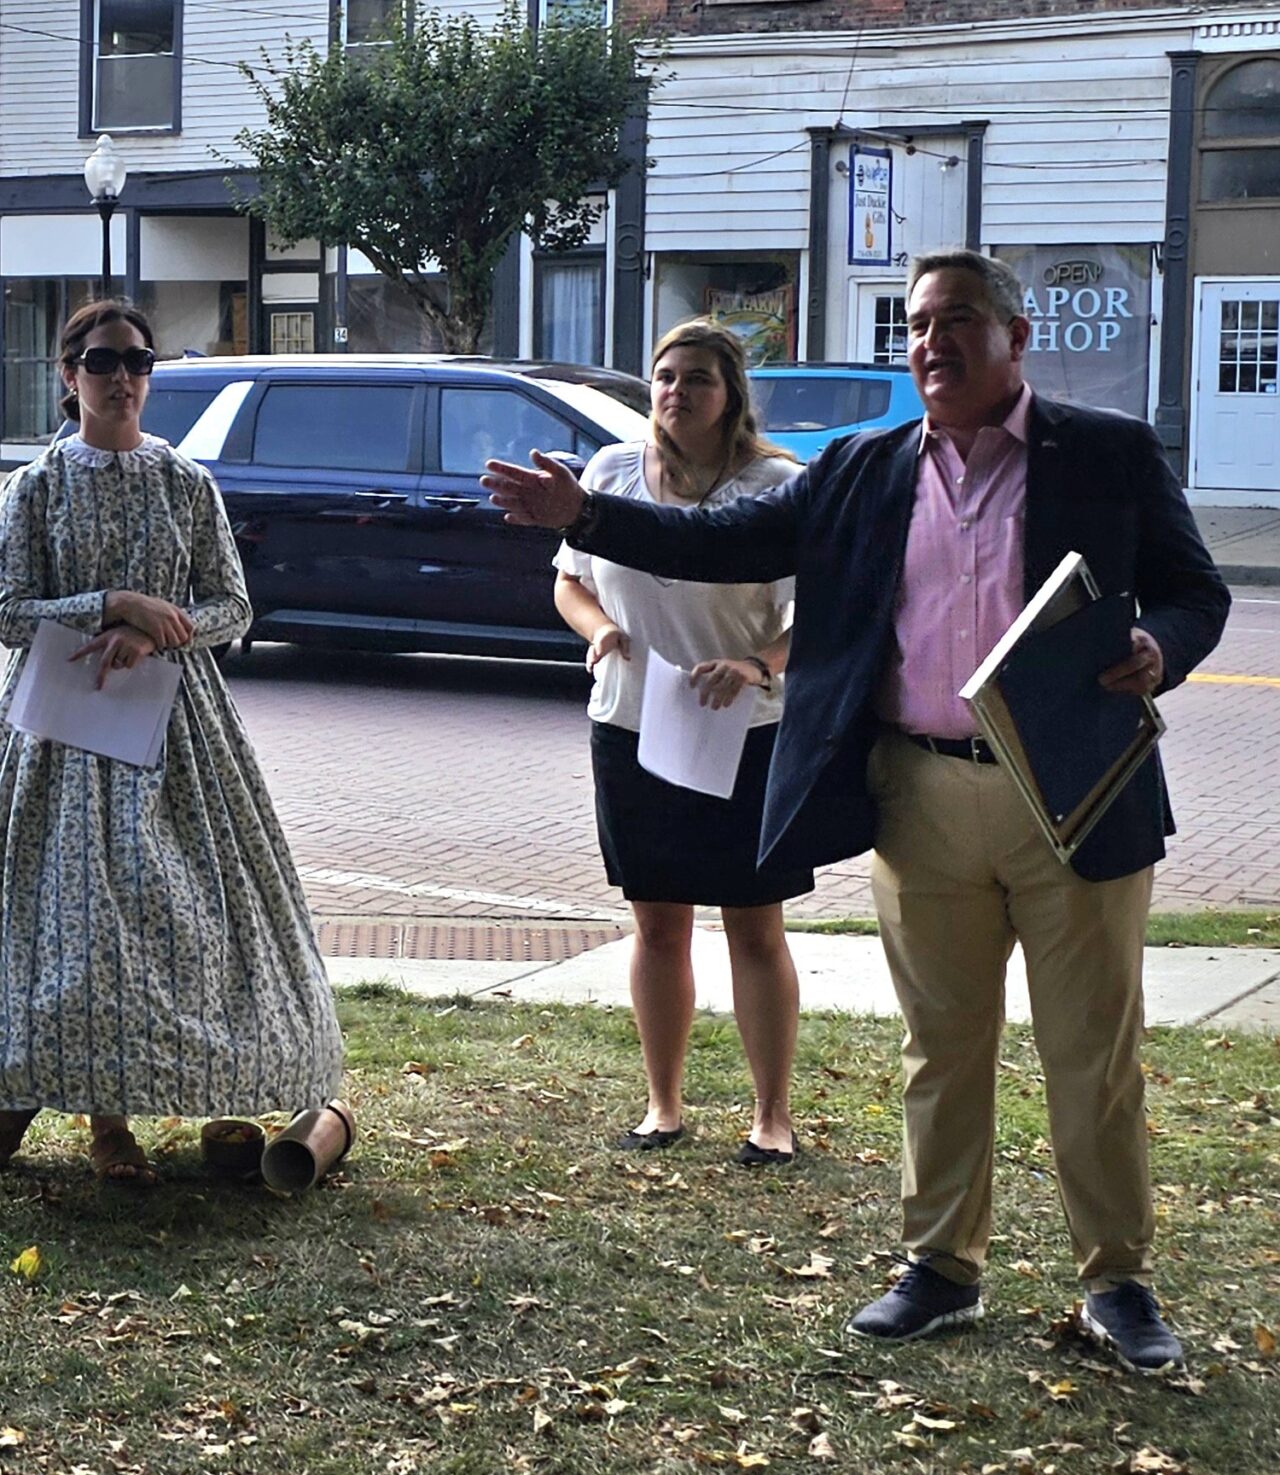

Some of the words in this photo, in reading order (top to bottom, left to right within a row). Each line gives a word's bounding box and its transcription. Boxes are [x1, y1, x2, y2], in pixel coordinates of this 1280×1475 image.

[1043, 263, 1101, 285] OPEN
[1023, 287, 1133, 318] APOR
[1029, 321, 1121, 351] HOP
